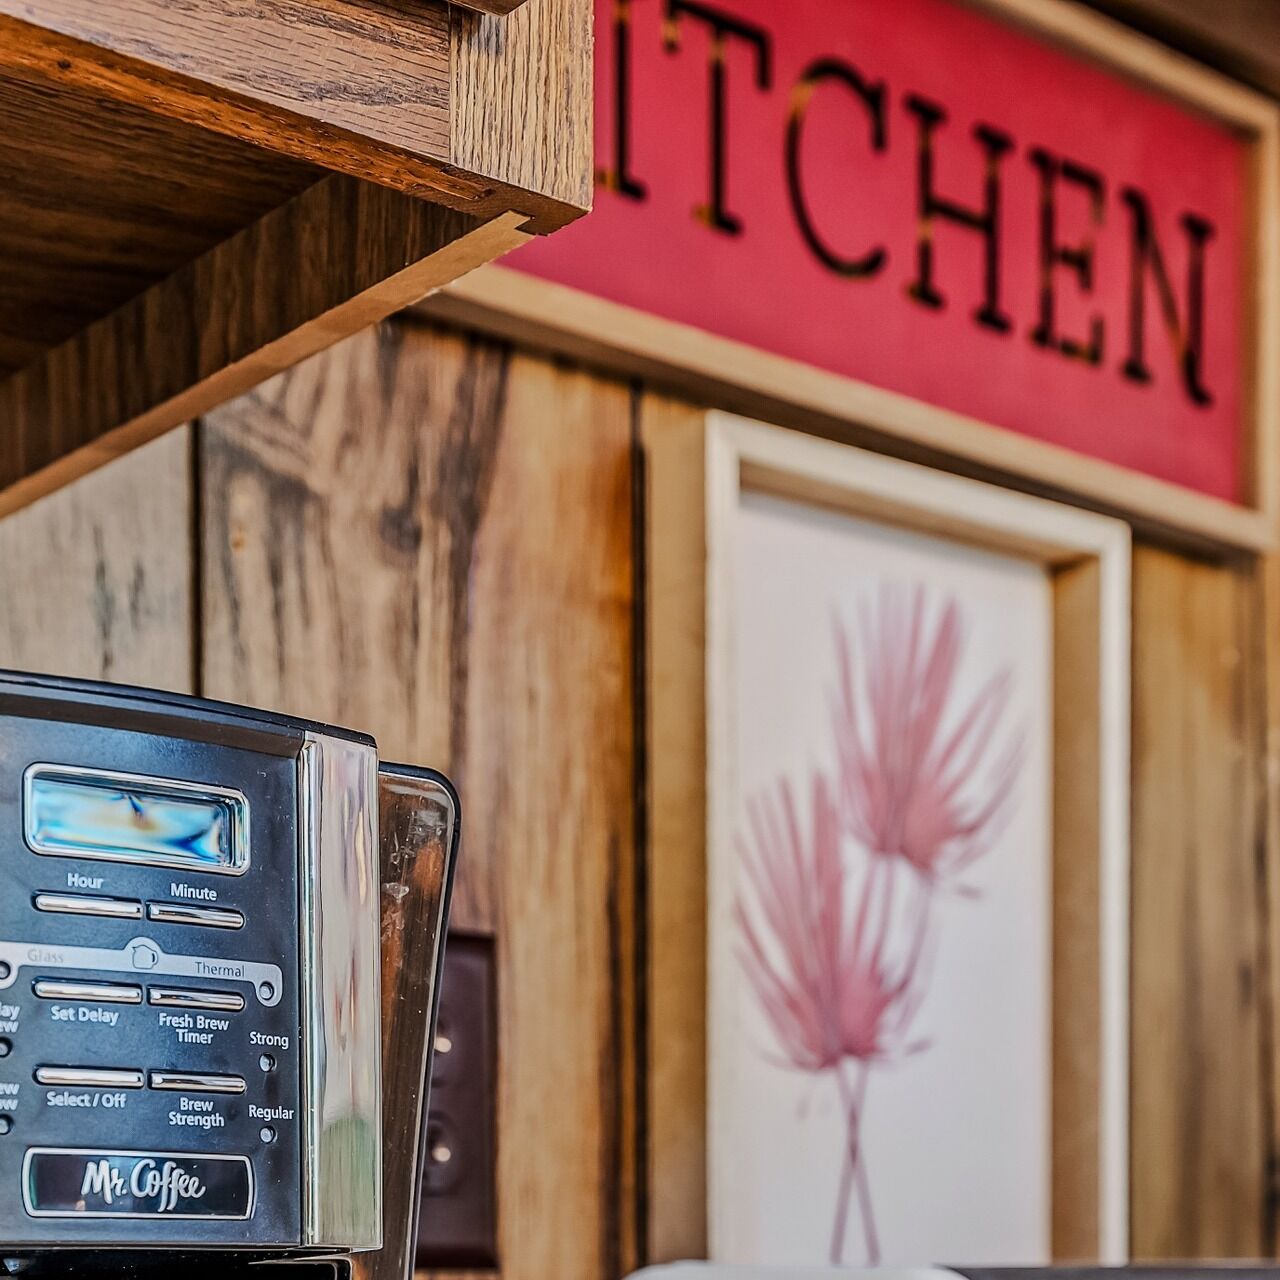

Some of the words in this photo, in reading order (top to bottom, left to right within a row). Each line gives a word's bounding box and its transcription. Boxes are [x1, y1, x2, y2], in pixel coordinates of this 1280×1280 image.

[596, 0, 1215, 407] ITCHEN
[67, 873, 104, 889] Hour
[170, 883, 218, 901] Minute
[27, 949, 65, 964] Glass
[194, 961, 246, 978] Thermal
[50, 1006, 76, 1021] Set
[78, 1007, 120, 1026] Delay
[159, 1013, 194, 1029] Fresh
[196, 1016, 230, 1031] Brew
[176, 1029, 214, 1045] Timer
[249, 1031, 289, 1050] Strong
[46, 1091, 91, 1106] Select
[92, 1093, 100, 1107] /
[101, 1093, 127, 1108] Off
[180, 1097, 214, 1112] Brew
[168, 1112, 225, 1129] Strength
[248, 1105, 295, 1121] Regular
[81, 1160, 128, 1205] Mr.
[130, 1158, 206, 1213] Coffee
